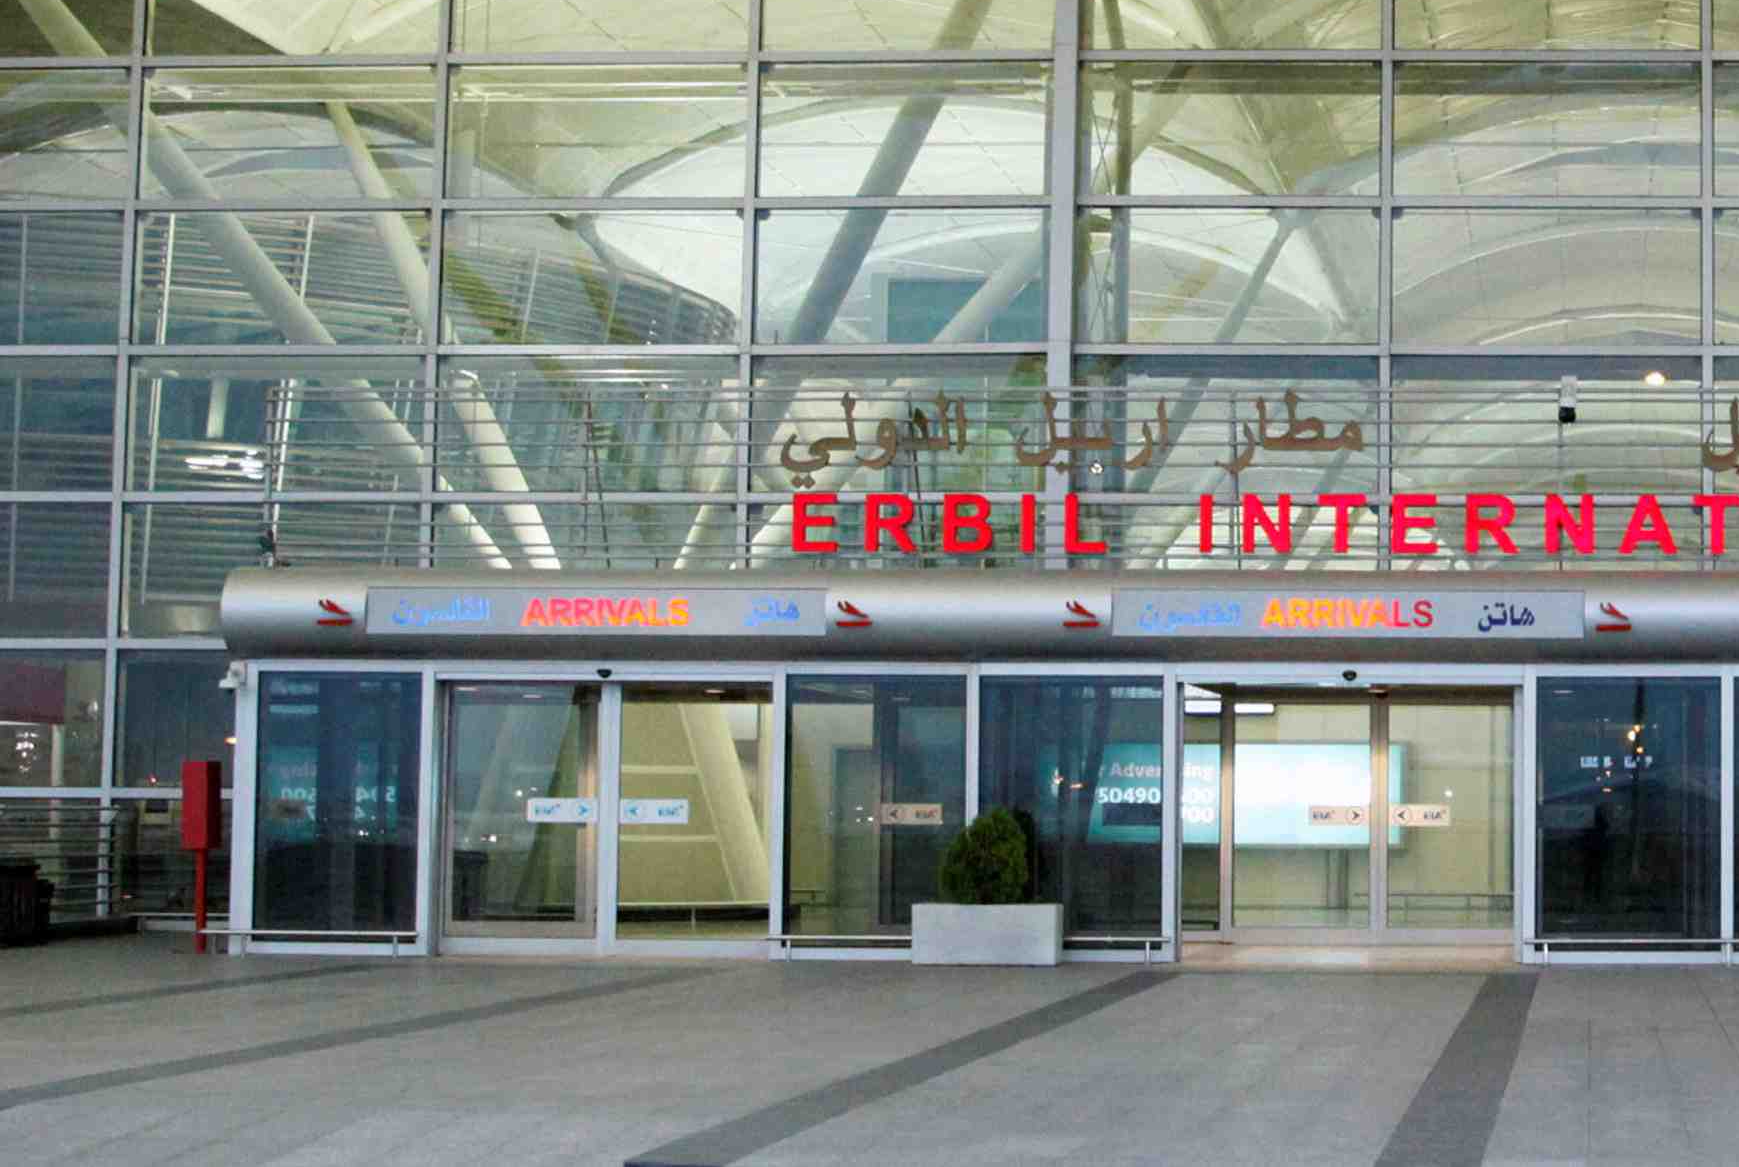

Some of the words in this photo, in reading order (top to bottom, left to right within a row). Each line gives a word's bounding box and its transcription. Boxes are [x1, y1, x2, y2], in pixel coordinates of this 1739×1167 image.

[781, 390, 967, 489] الدولي
[1214, 387, 1364, 474] مطار
[792, 493, 1108, 554] ERBIL
[521, 597, 690, 627] ARRIVALS
[1261, 599, 1434, 629] ARRIVALS
[1477, 602, 1535, 631] هاتن
